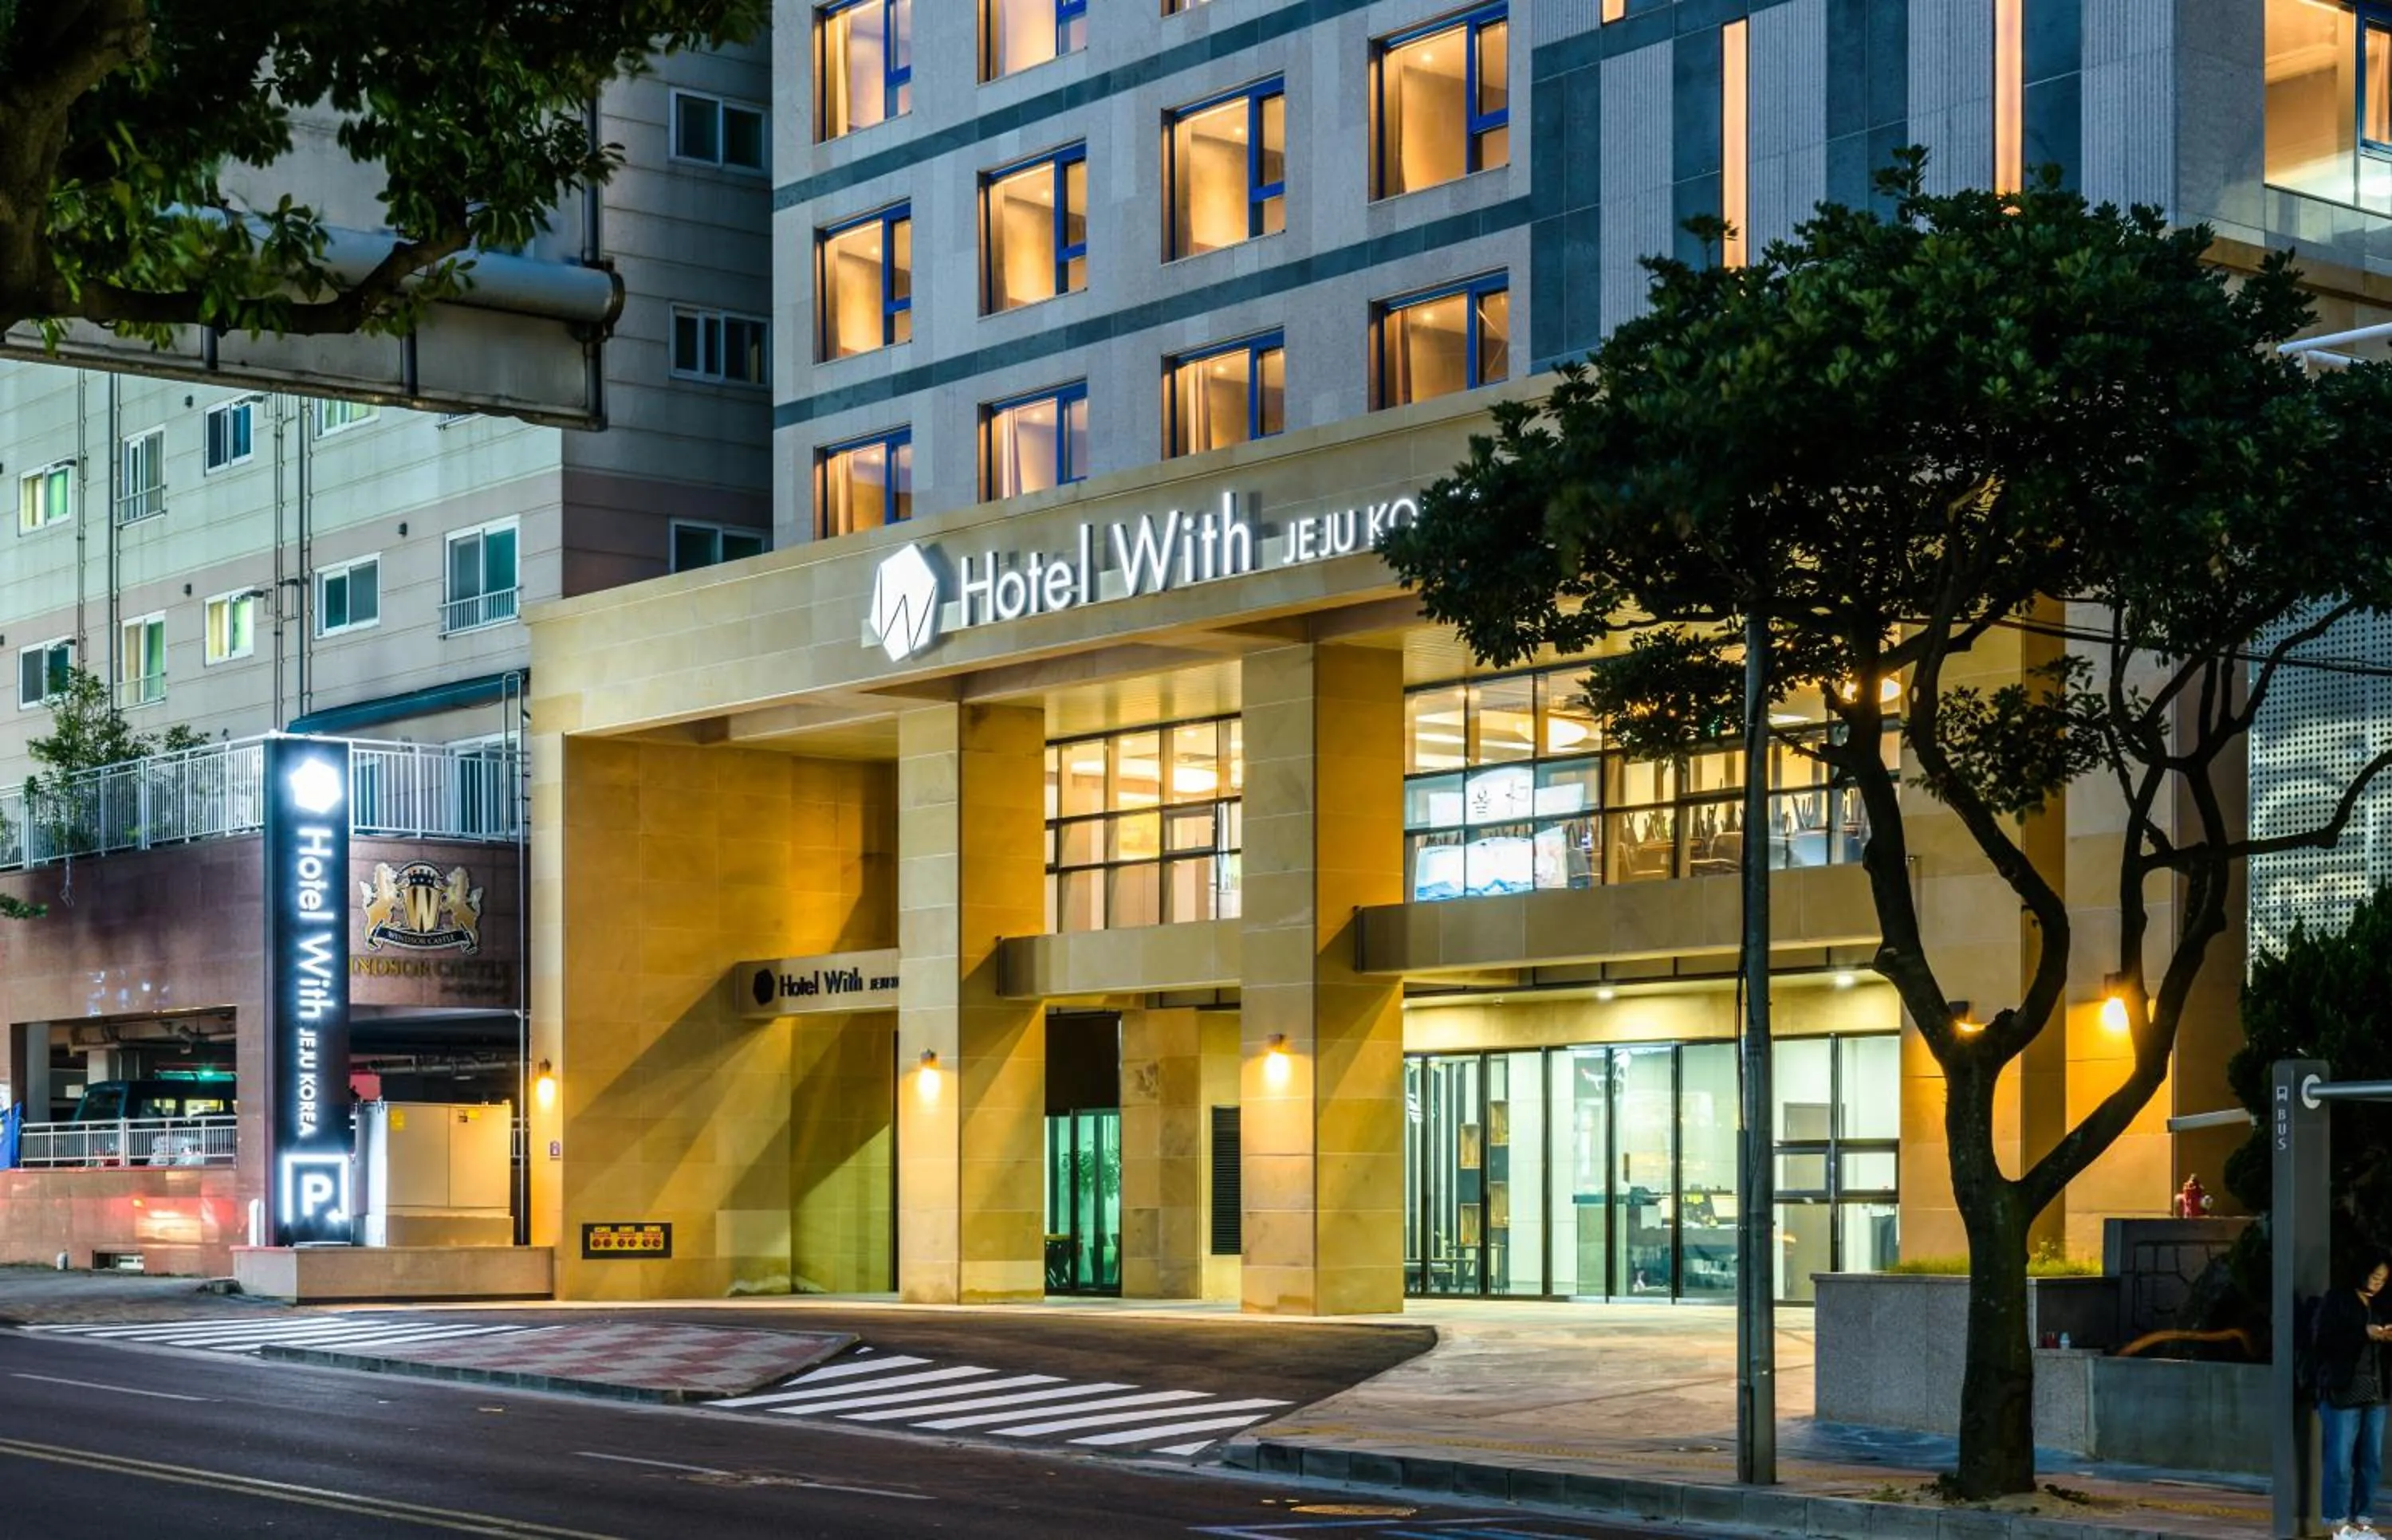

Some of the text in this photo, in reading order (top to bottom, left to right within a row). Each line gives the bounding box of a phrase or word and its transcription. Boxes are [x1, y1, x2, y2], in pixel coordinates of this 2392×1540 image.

[961, 523, 1093, 627] Hotel
[1113, 491, 1254, 596] With
[1282, 509, 1355, 564] JEJU
[388, 931, 456, 945] WINDSOR CASTLE
[297, 827, 336, 1138] Hotel With JEJU KOREA
[349, 957, 431, 978] INDSOR
[779, 969, 820, 998] Hotel
[824, 966, 864, 995] With
[2277, 1108, 2287, 1150] BUS
[301, 1172, 333, 1217] P
